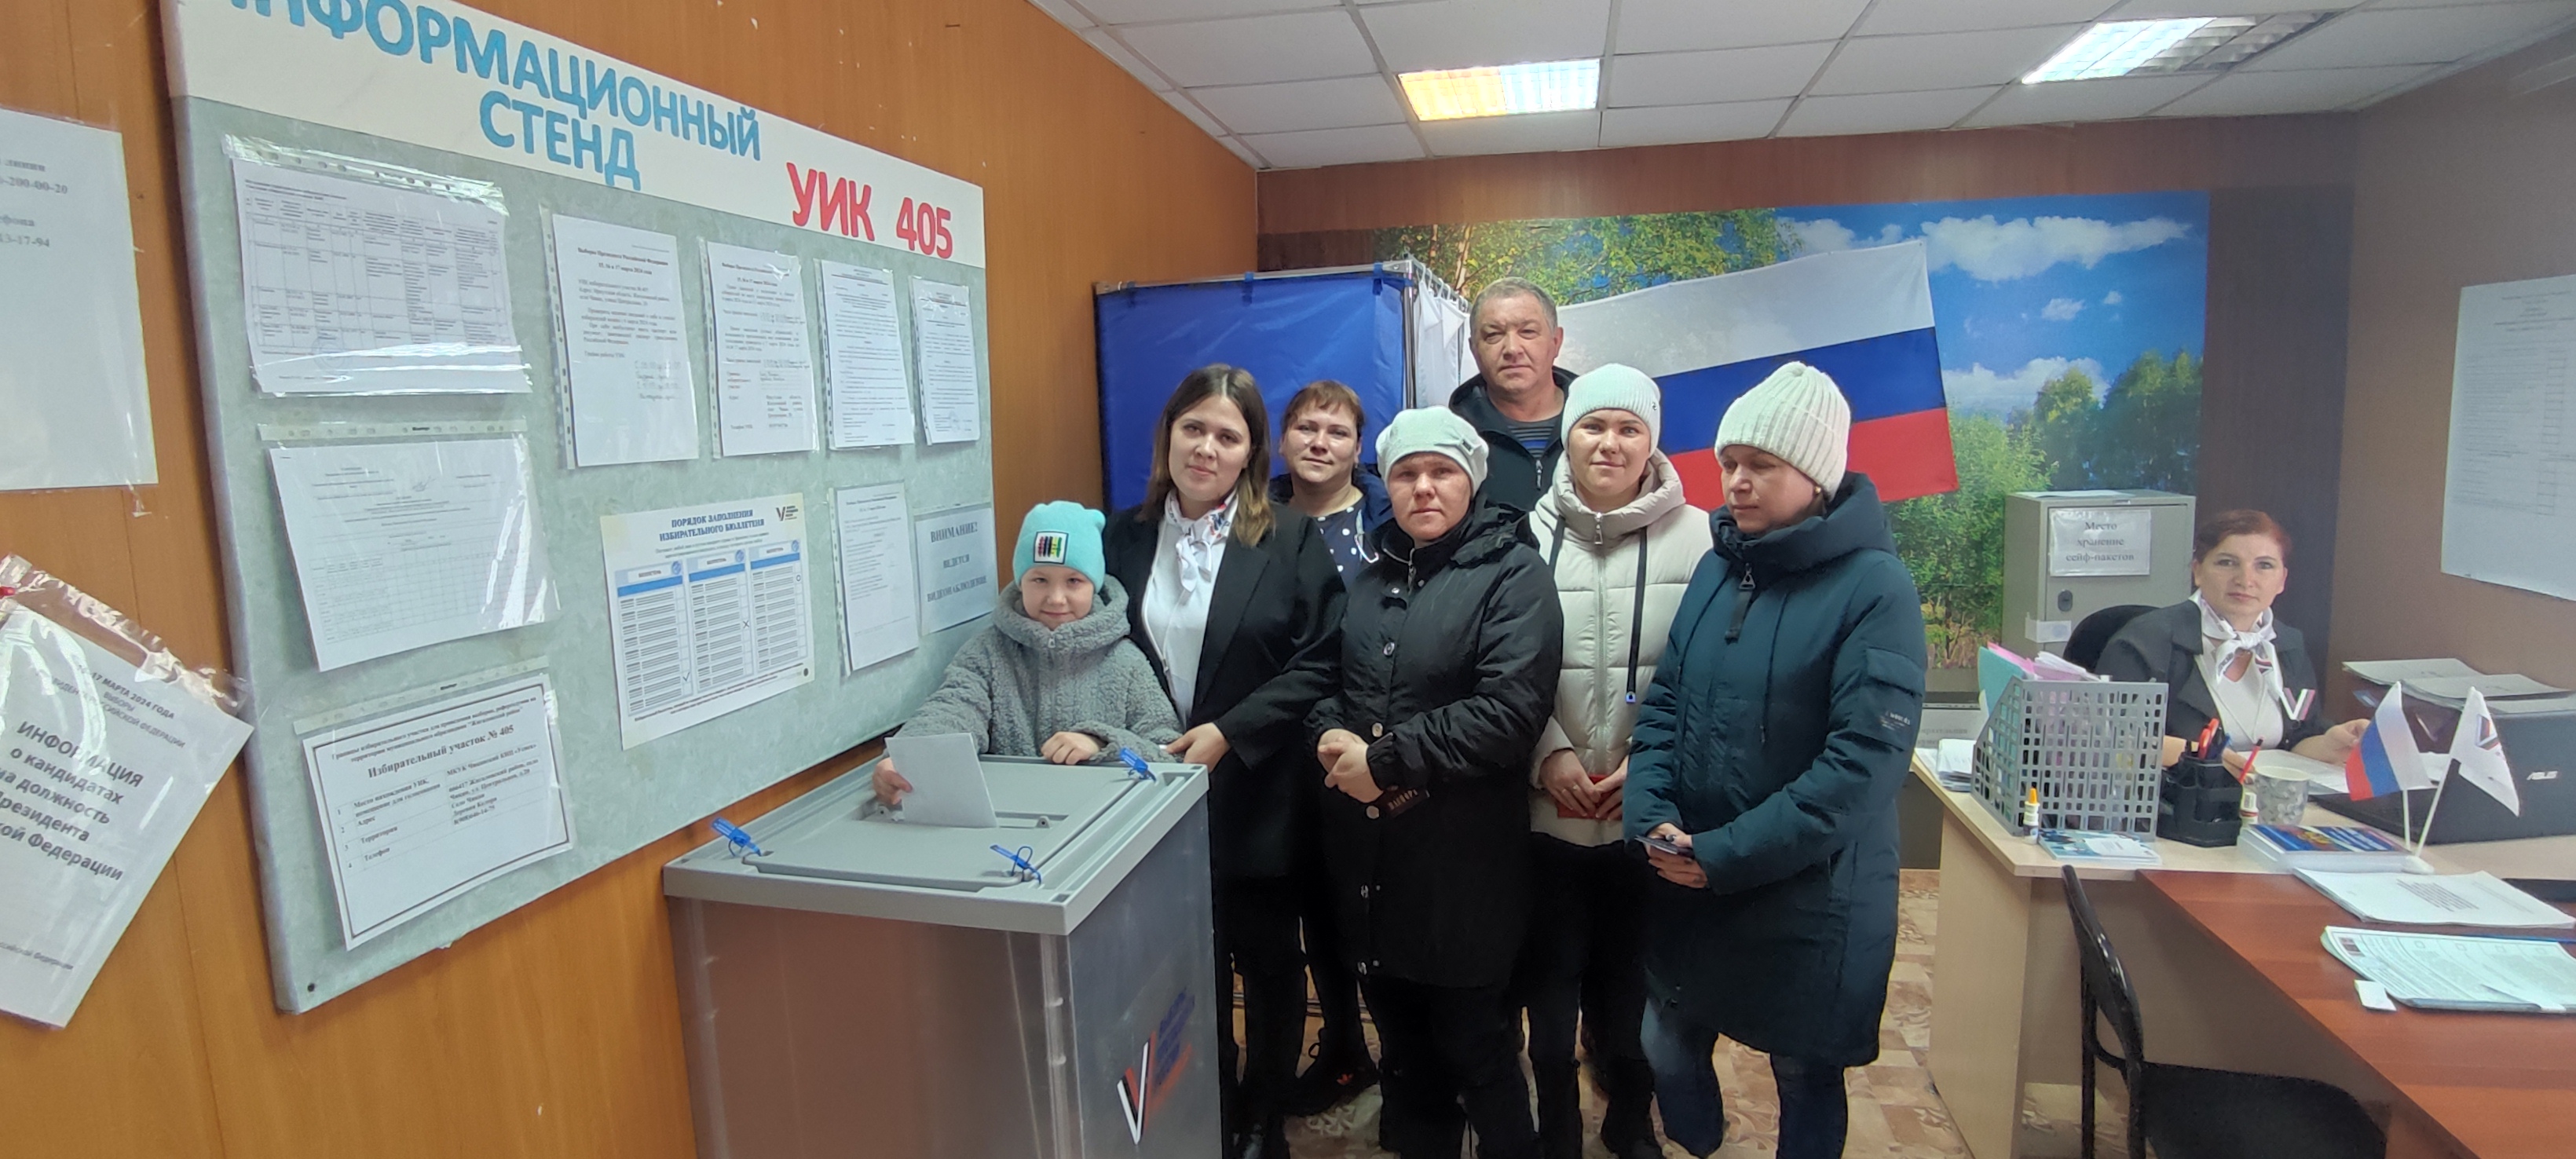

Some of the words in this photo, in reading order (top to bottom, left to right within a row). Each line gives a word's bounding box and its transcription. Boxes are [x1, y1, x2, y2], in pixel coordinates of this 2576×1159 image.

[231, 0, 760, 161] ФОРМАЦИОННЫЙ
[480, 90, 641, 191] СТЕНД
[786, 162, 875, 241] УИК
[896, 197, 953, 259] 405
[659, 526, 723, 542] ИЗБИРАТЕЛЬНОГО
[671, 514, 706, 528] ПОРЯДОК
[931, 521, 978, 543] ВНИМАНИЕ!
[2077, 538, 2124, 547] хранение
[2085, 521, 2117, 531] Место
[2066, 553, 2135, 563] сейф-пакетов
[101, 677, 130, 698] МАРТА
[130, 693, 152, 708] 2024
[151, 703, 174, 719] ГОДА
[368, 745, 447, 778] Избирательный
[448, 734, 486, 754] участок
[486, 729, 498, 740] №
[499, 725, 514, 736] 405
[10, 748, 23, 759] о
[24, 754, 124, 805] кандидатах
[16, 778, 111, 824] должность
[27, 833, 123, 881] Федерации
